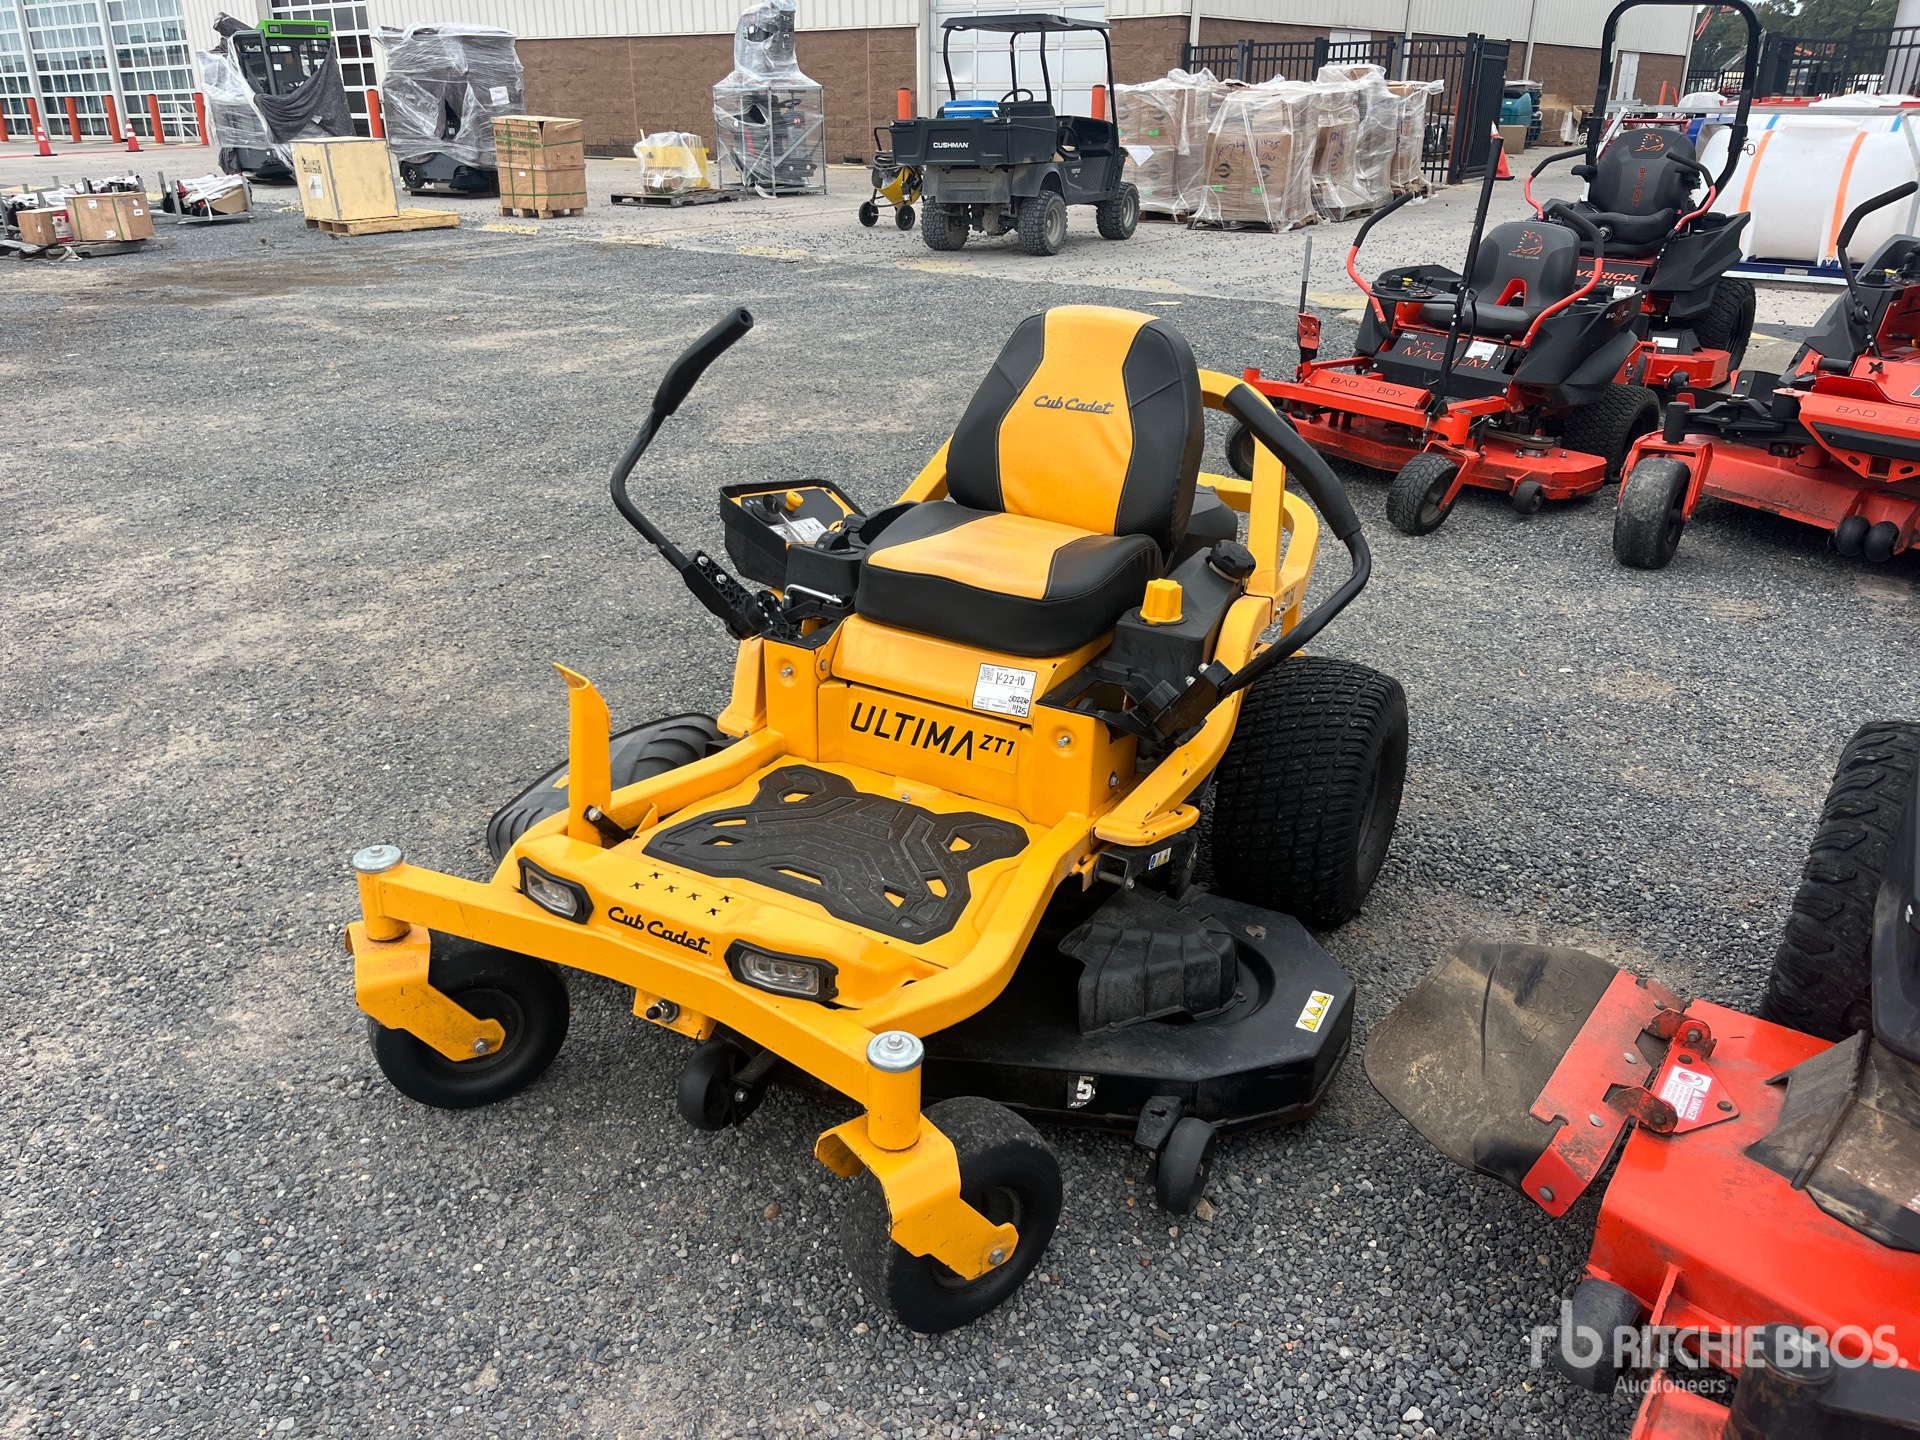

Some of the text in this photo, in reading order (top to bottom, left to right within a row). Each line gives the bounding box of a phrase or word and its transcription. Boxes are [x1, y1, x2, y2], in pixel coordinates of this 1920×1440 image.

[1576, 269, 1639, 282] VERICK
[1331, 377, 1407, 398] BAD BOY
[1034, 394, 1115, 415] Cub Cadet
[1836, 405, 1877, 418] BAD
[850, 702, 1016, 761] ULTIMA ZT1
[607, 906, 711, 955] Cub Cadet
[1076, 1075, 1096, 1100] 5
[1685, 1097, 1703, 1120] DANGER
